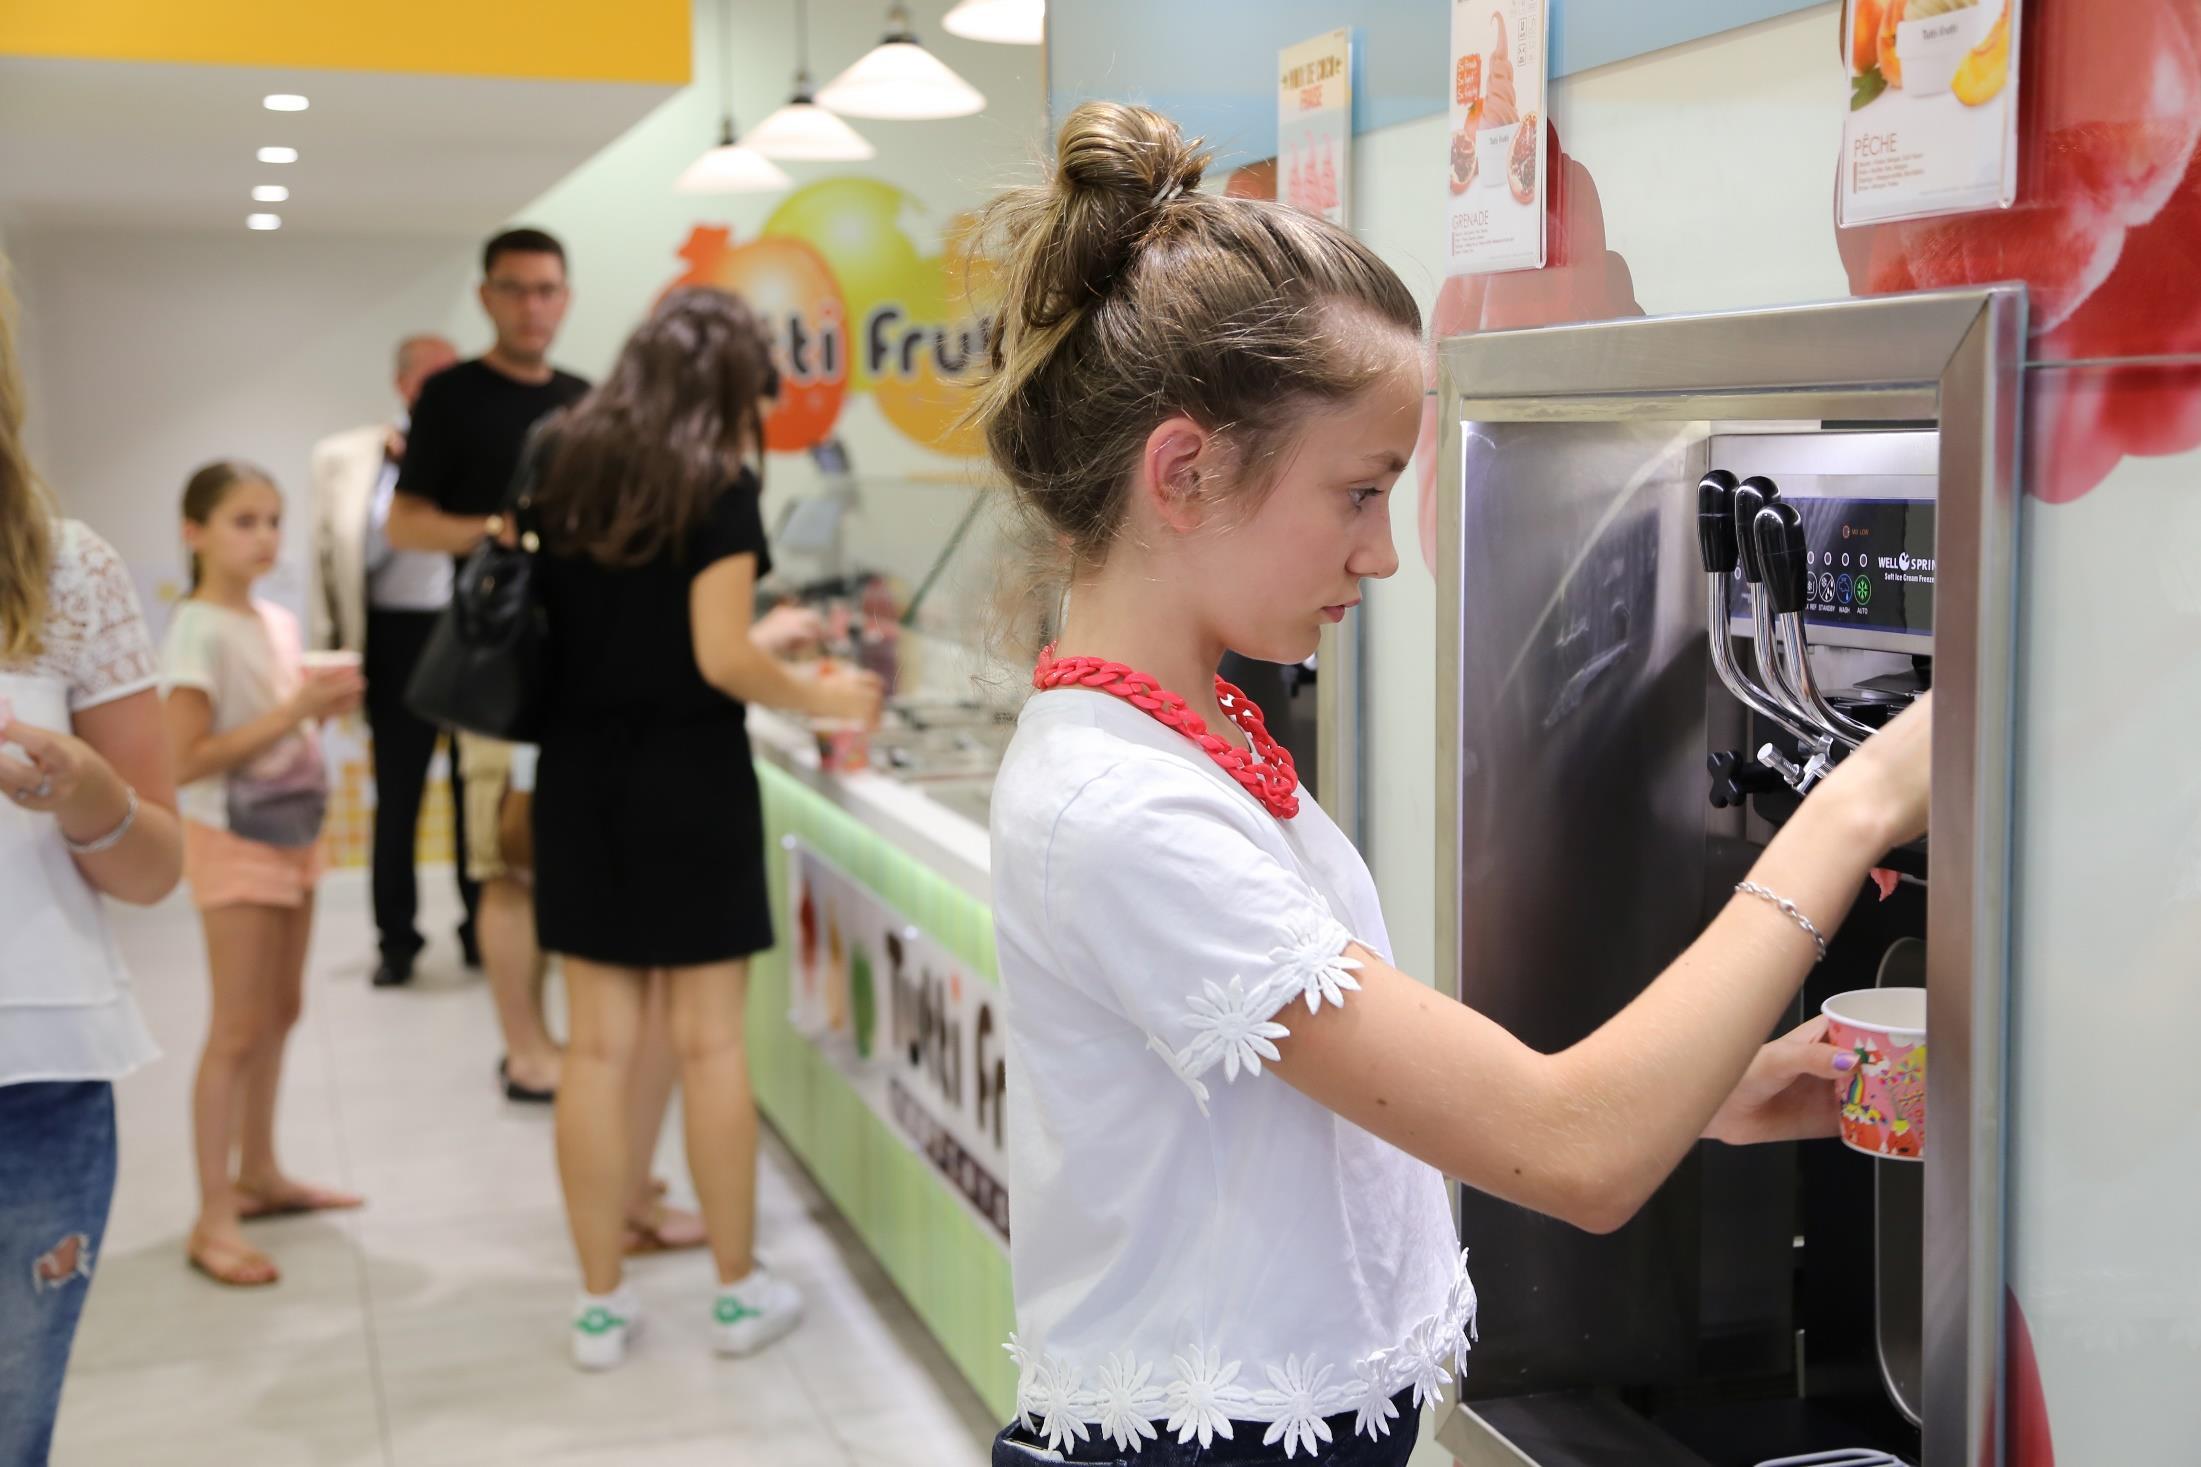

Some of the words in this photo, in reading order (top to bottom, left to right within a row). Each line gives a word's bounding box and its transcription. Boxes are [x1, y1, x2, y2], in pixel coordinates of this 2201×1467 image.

[1855, 133, 1897, 157] PÊCHE
[1452, 209, 1489, 230] GRENADE
[1878, 556, 1899, 569] WELL
[1911, 558, 1937, 571] SPRIN
[1884, 572, 1895, 581] Soft
[1895, 573, 1903, 581] Ice
[1903, 573, 1919, 583] Cream
[1919, 574, 1936, 584] Freeze
[1838, 606, 1851, 614] WASH
[1857, 607, 1869, 615] AUTO
